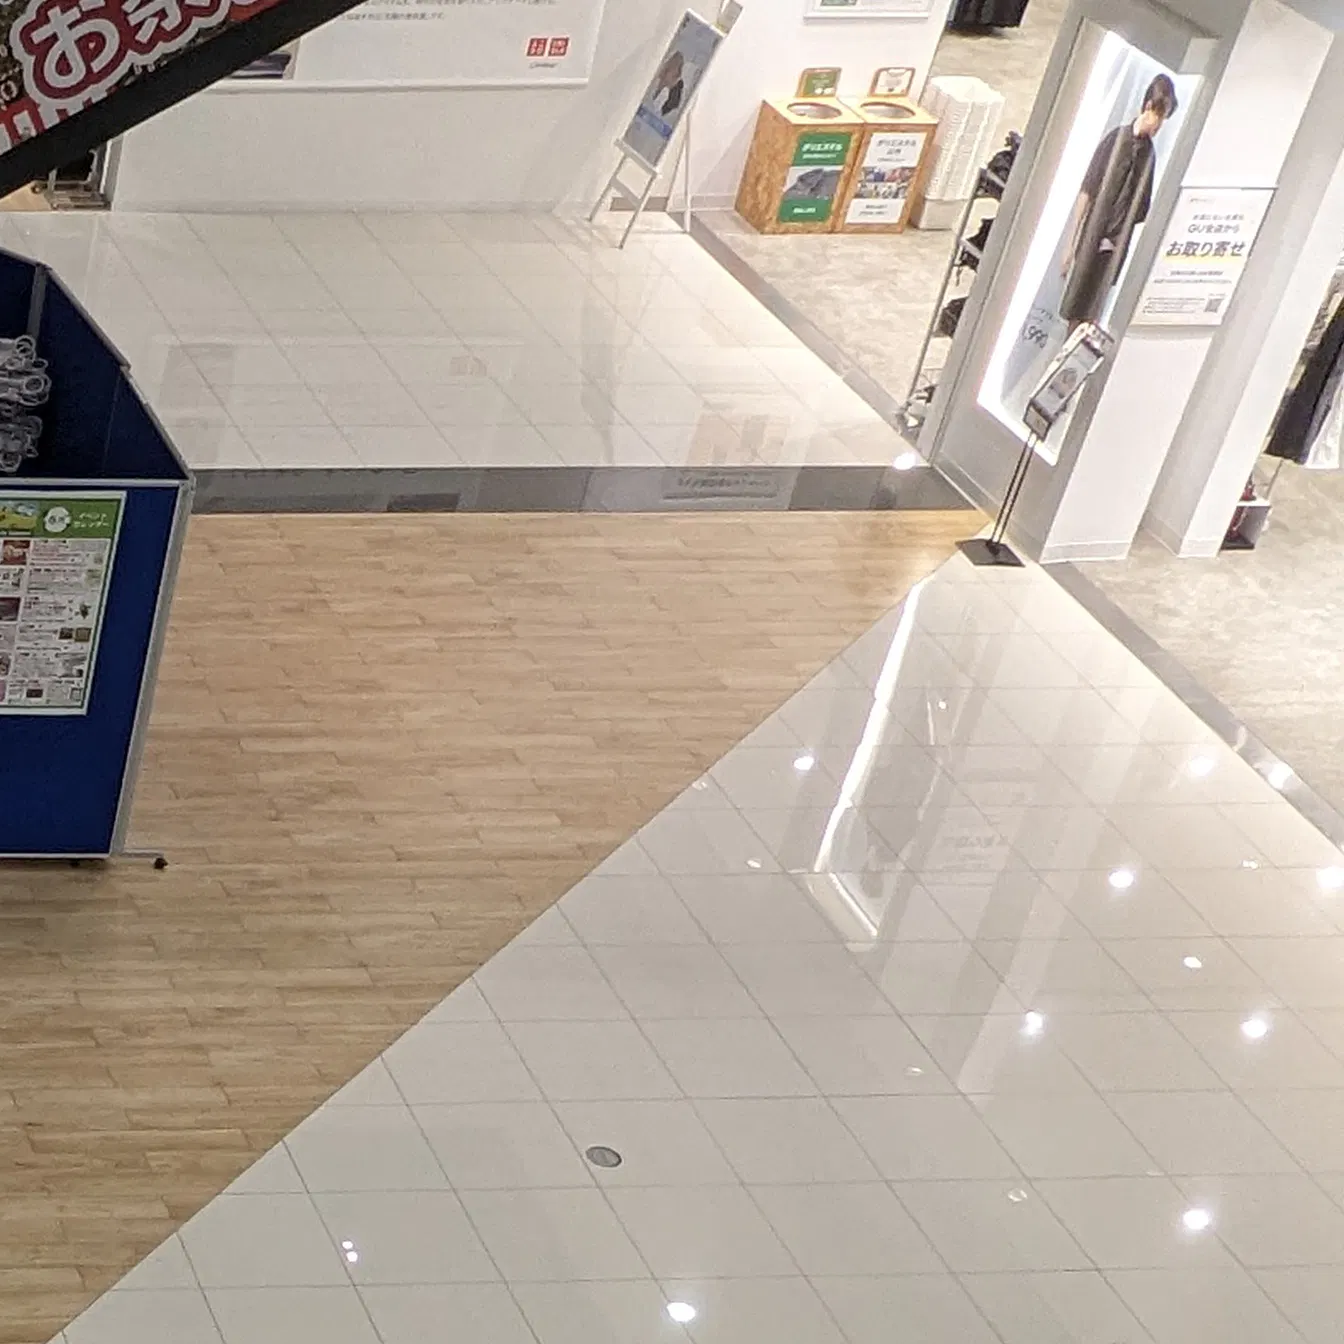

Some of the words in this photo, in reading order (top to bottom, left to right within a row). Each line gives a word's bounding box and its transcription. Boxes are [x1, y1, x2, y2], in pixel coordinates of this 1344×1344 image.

[1165, 240, 1247, 258] お取り寄せ
